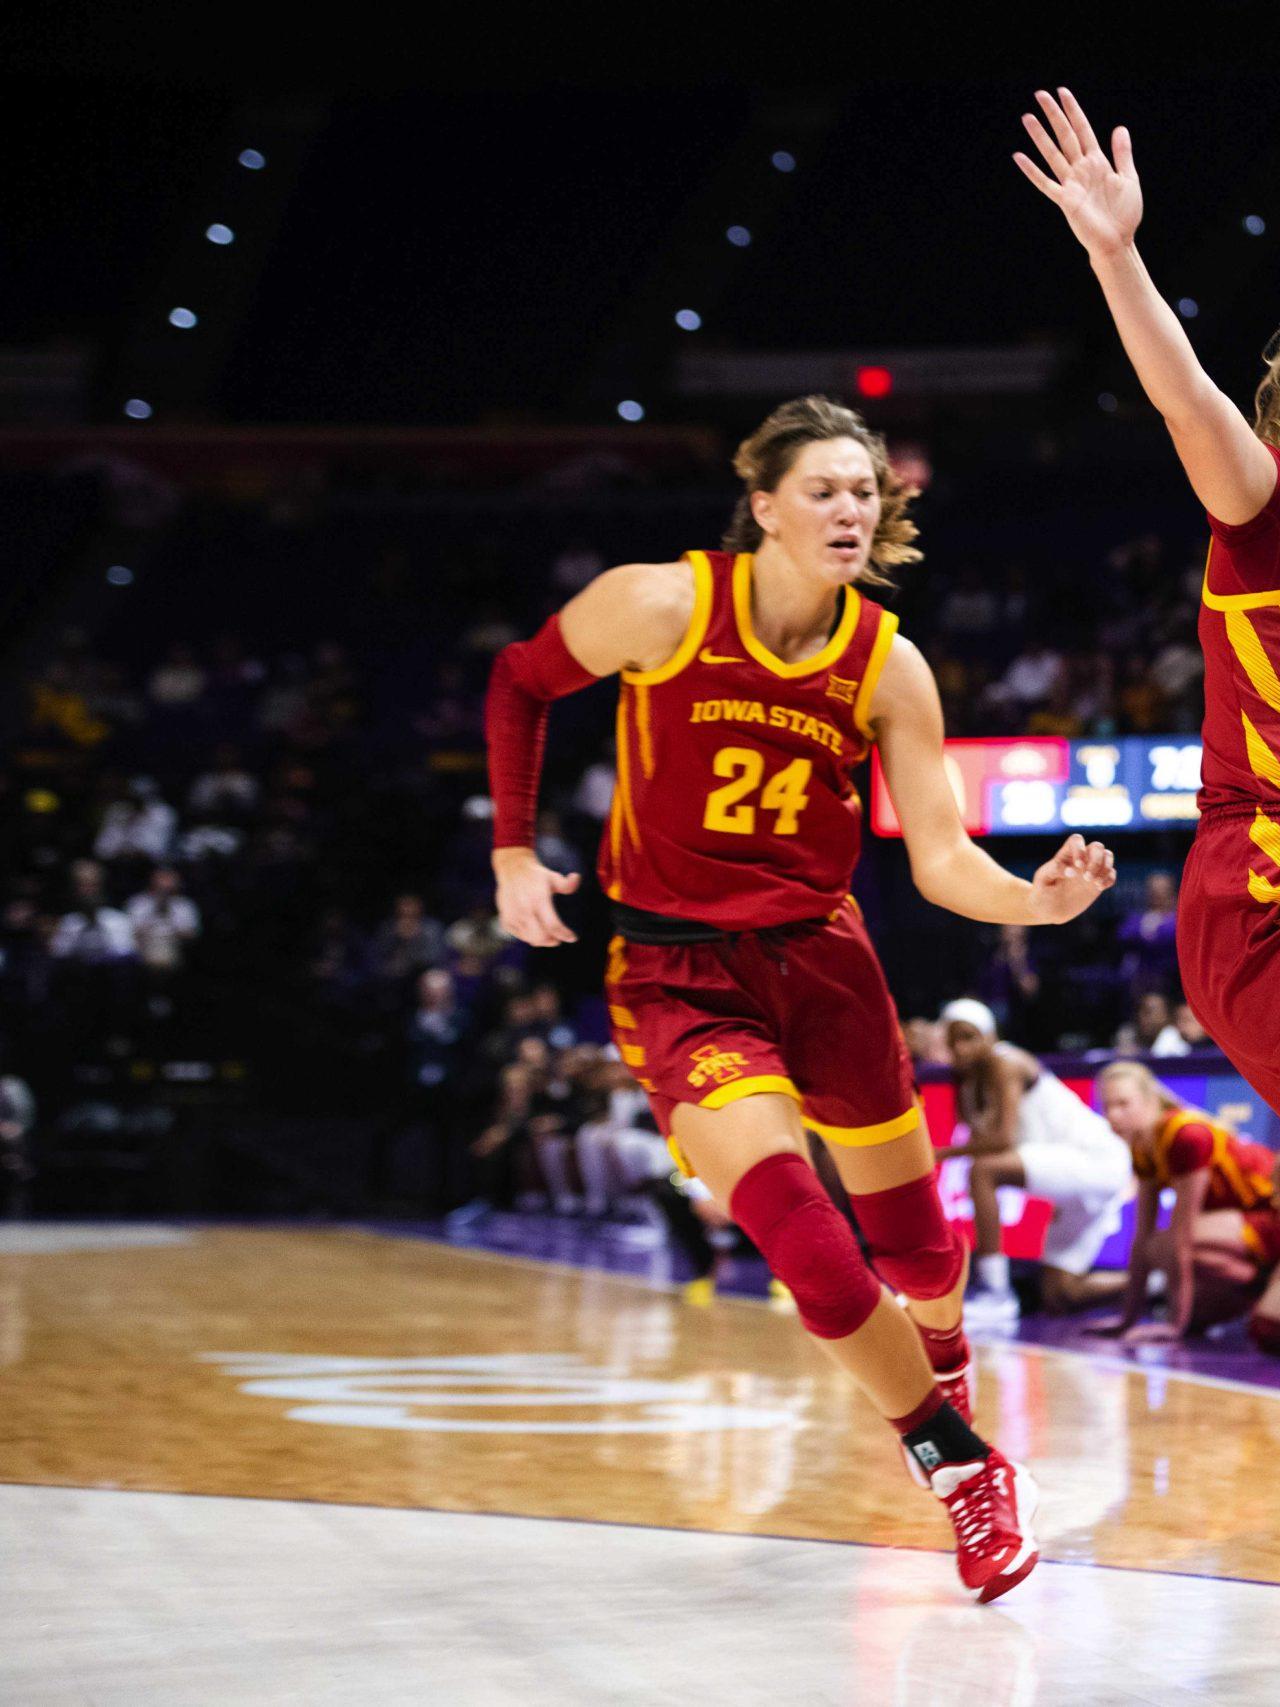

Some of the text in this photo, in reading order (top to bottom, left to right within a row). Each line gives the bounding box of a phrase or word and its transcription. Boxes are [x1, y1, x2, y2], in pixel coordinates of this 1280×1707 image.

[690, 699, 844, 757] IOWA STATE
[703, 746, 812, 835] 24
[686, 1052, 751, 1088] STATE
